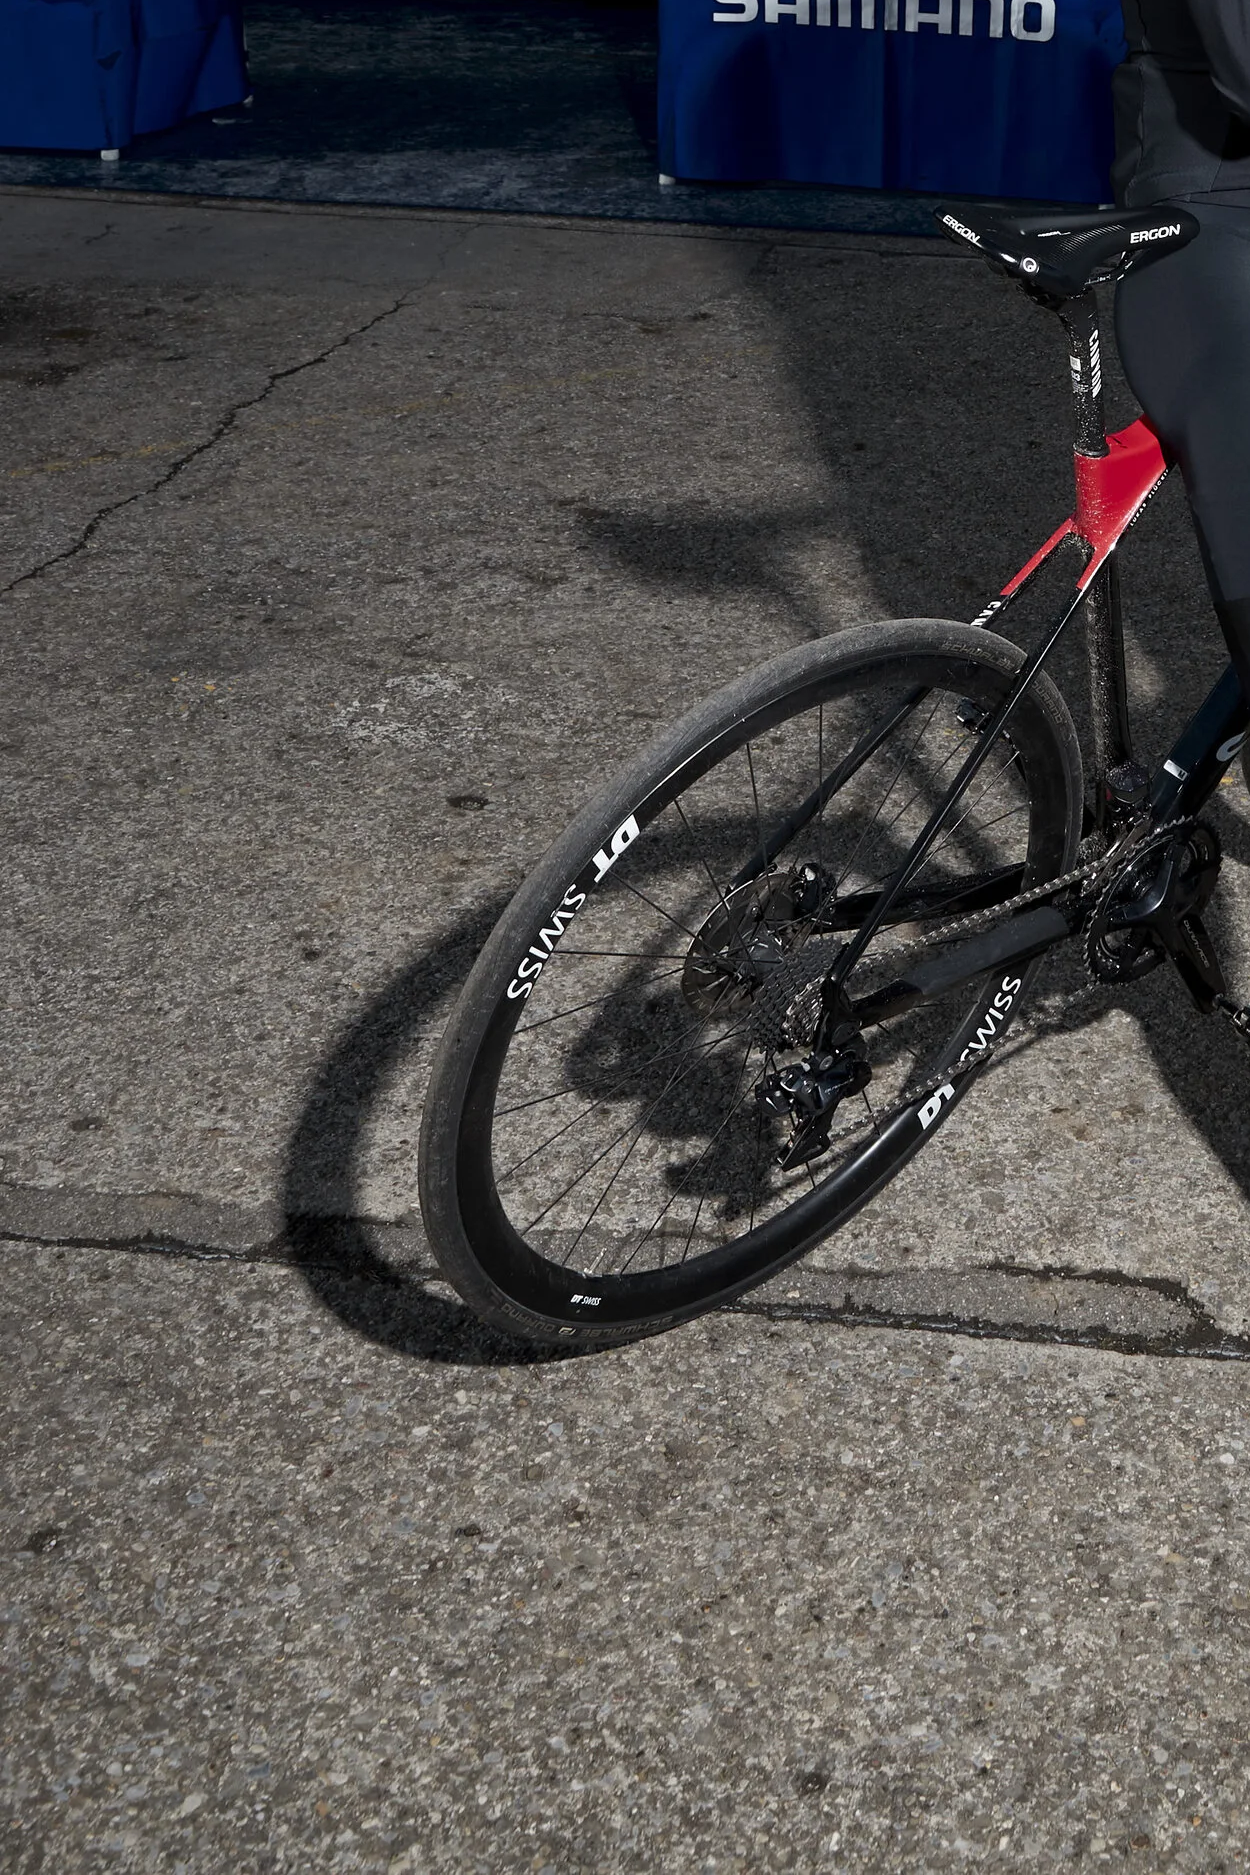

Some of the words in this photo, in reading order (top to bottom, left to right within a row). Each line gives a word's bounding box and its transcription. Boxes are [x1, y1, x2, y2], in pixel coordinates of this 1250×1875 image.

[942, 214, 981, 244] ERGON
[1129, 223, 1182, 245] ERGON
[592, 813, 641, 883] DT
[506, 883, 587, 1000] SWISS
[581, 1294, 603, 1307] SWISS
